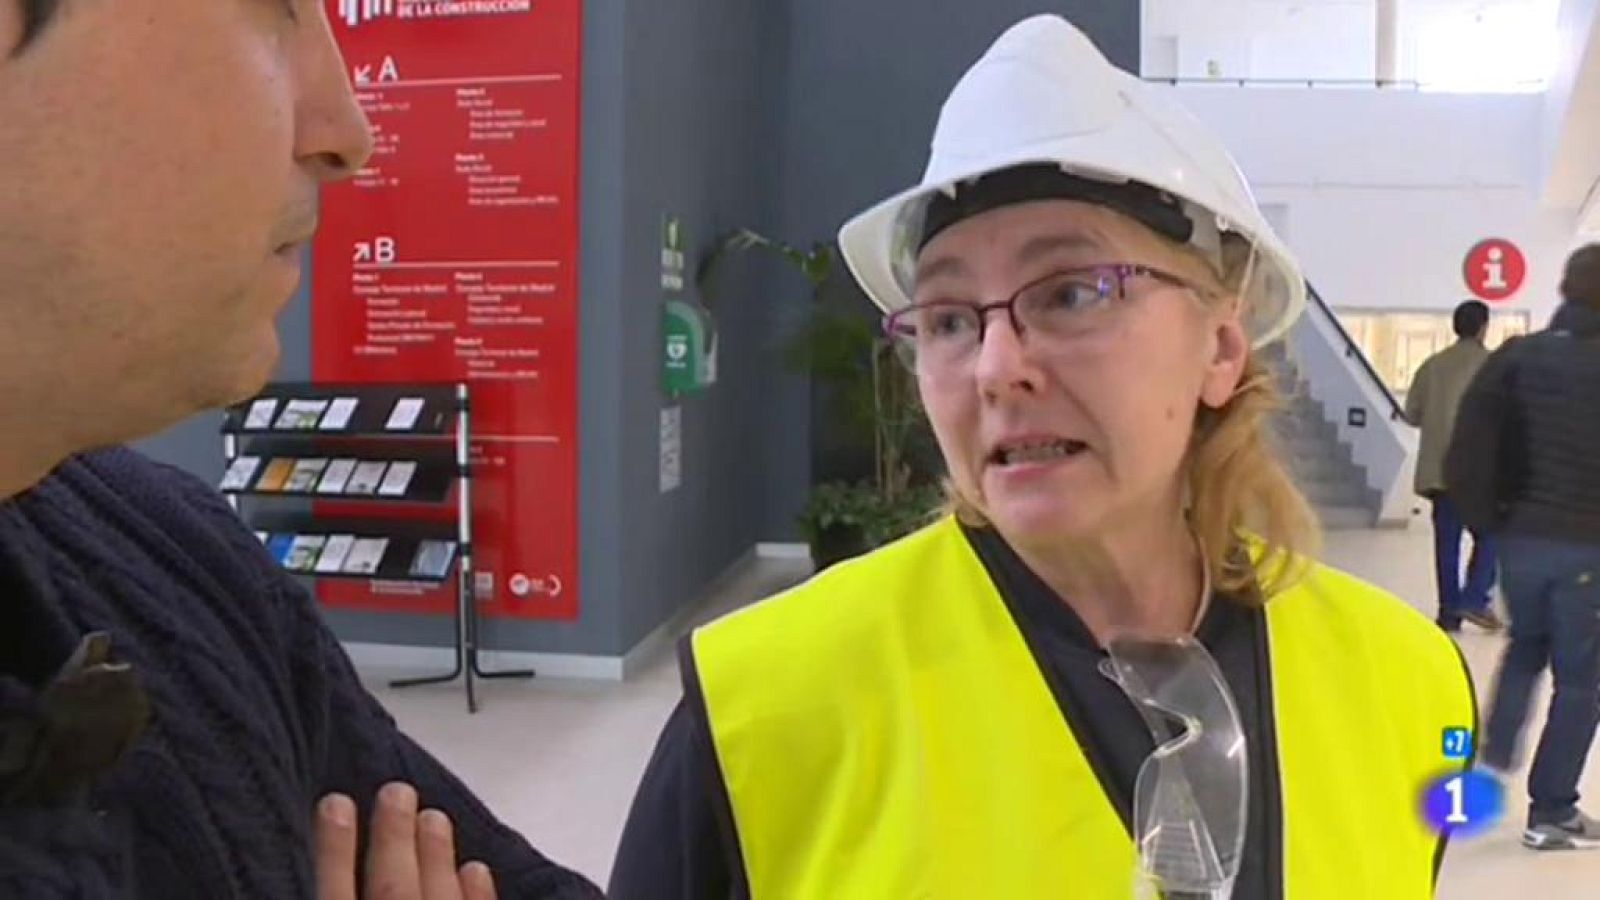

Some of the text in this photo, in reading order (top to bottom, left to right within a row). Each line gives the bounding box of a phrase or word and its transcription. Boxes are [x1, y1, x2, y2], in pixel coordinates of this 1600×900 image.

[397, 3, 414, 17] DE
[416, 2, 432, 16] LA
[378, 55, 398, 82] A
[375, 236, 395, 262] B
